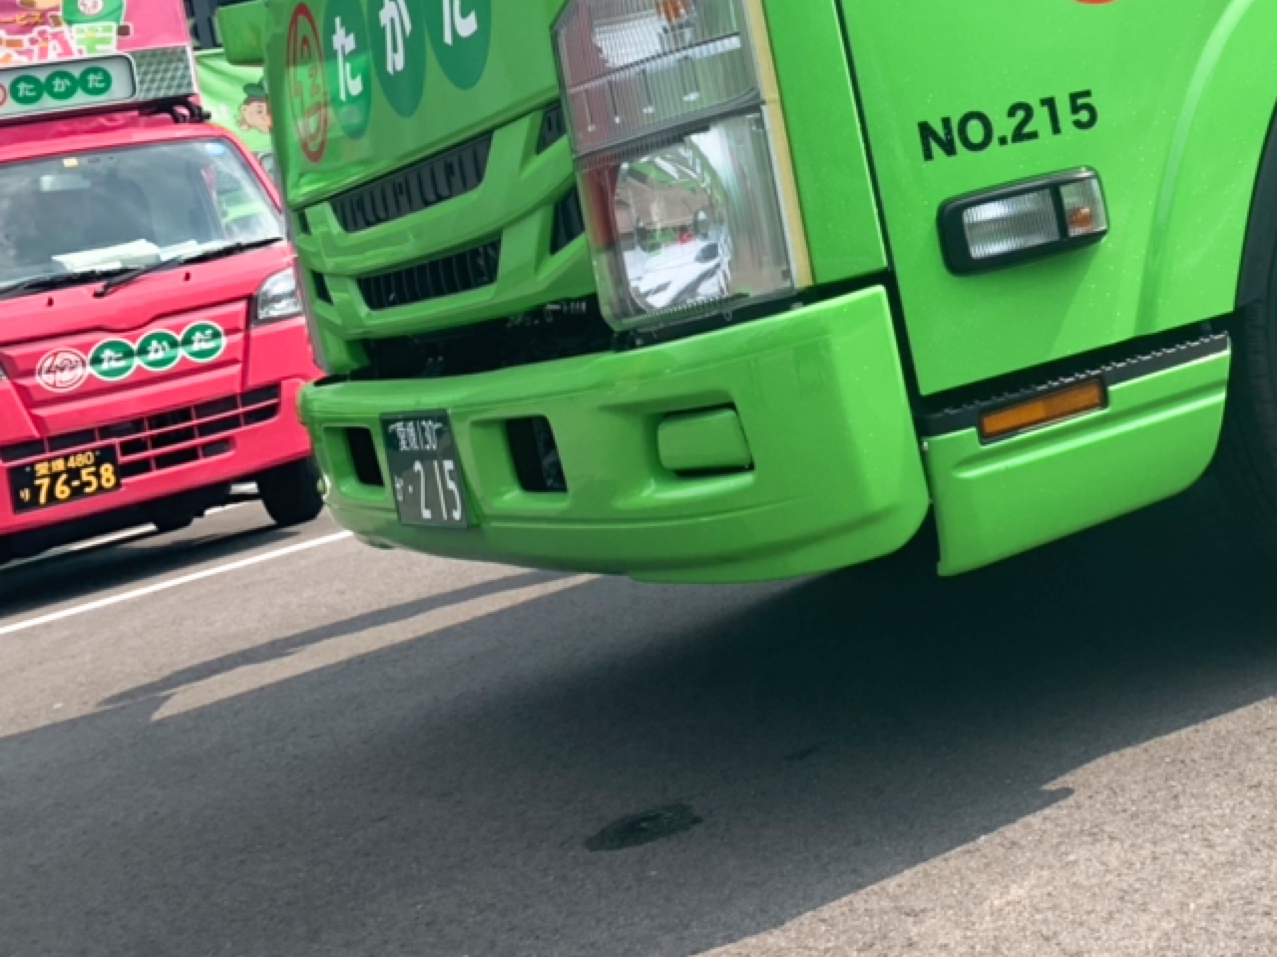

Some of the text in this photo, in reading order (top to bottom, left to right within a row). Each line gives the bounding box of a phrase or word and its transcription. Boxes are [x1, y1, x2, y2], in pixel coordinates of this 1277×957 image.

[16, 71, 107, 98] たかだ
[917, 89, 1098, 161] NO.215
[101, 329, 216, 369] たかだ
[34, 463, 116, 505] 76-58
